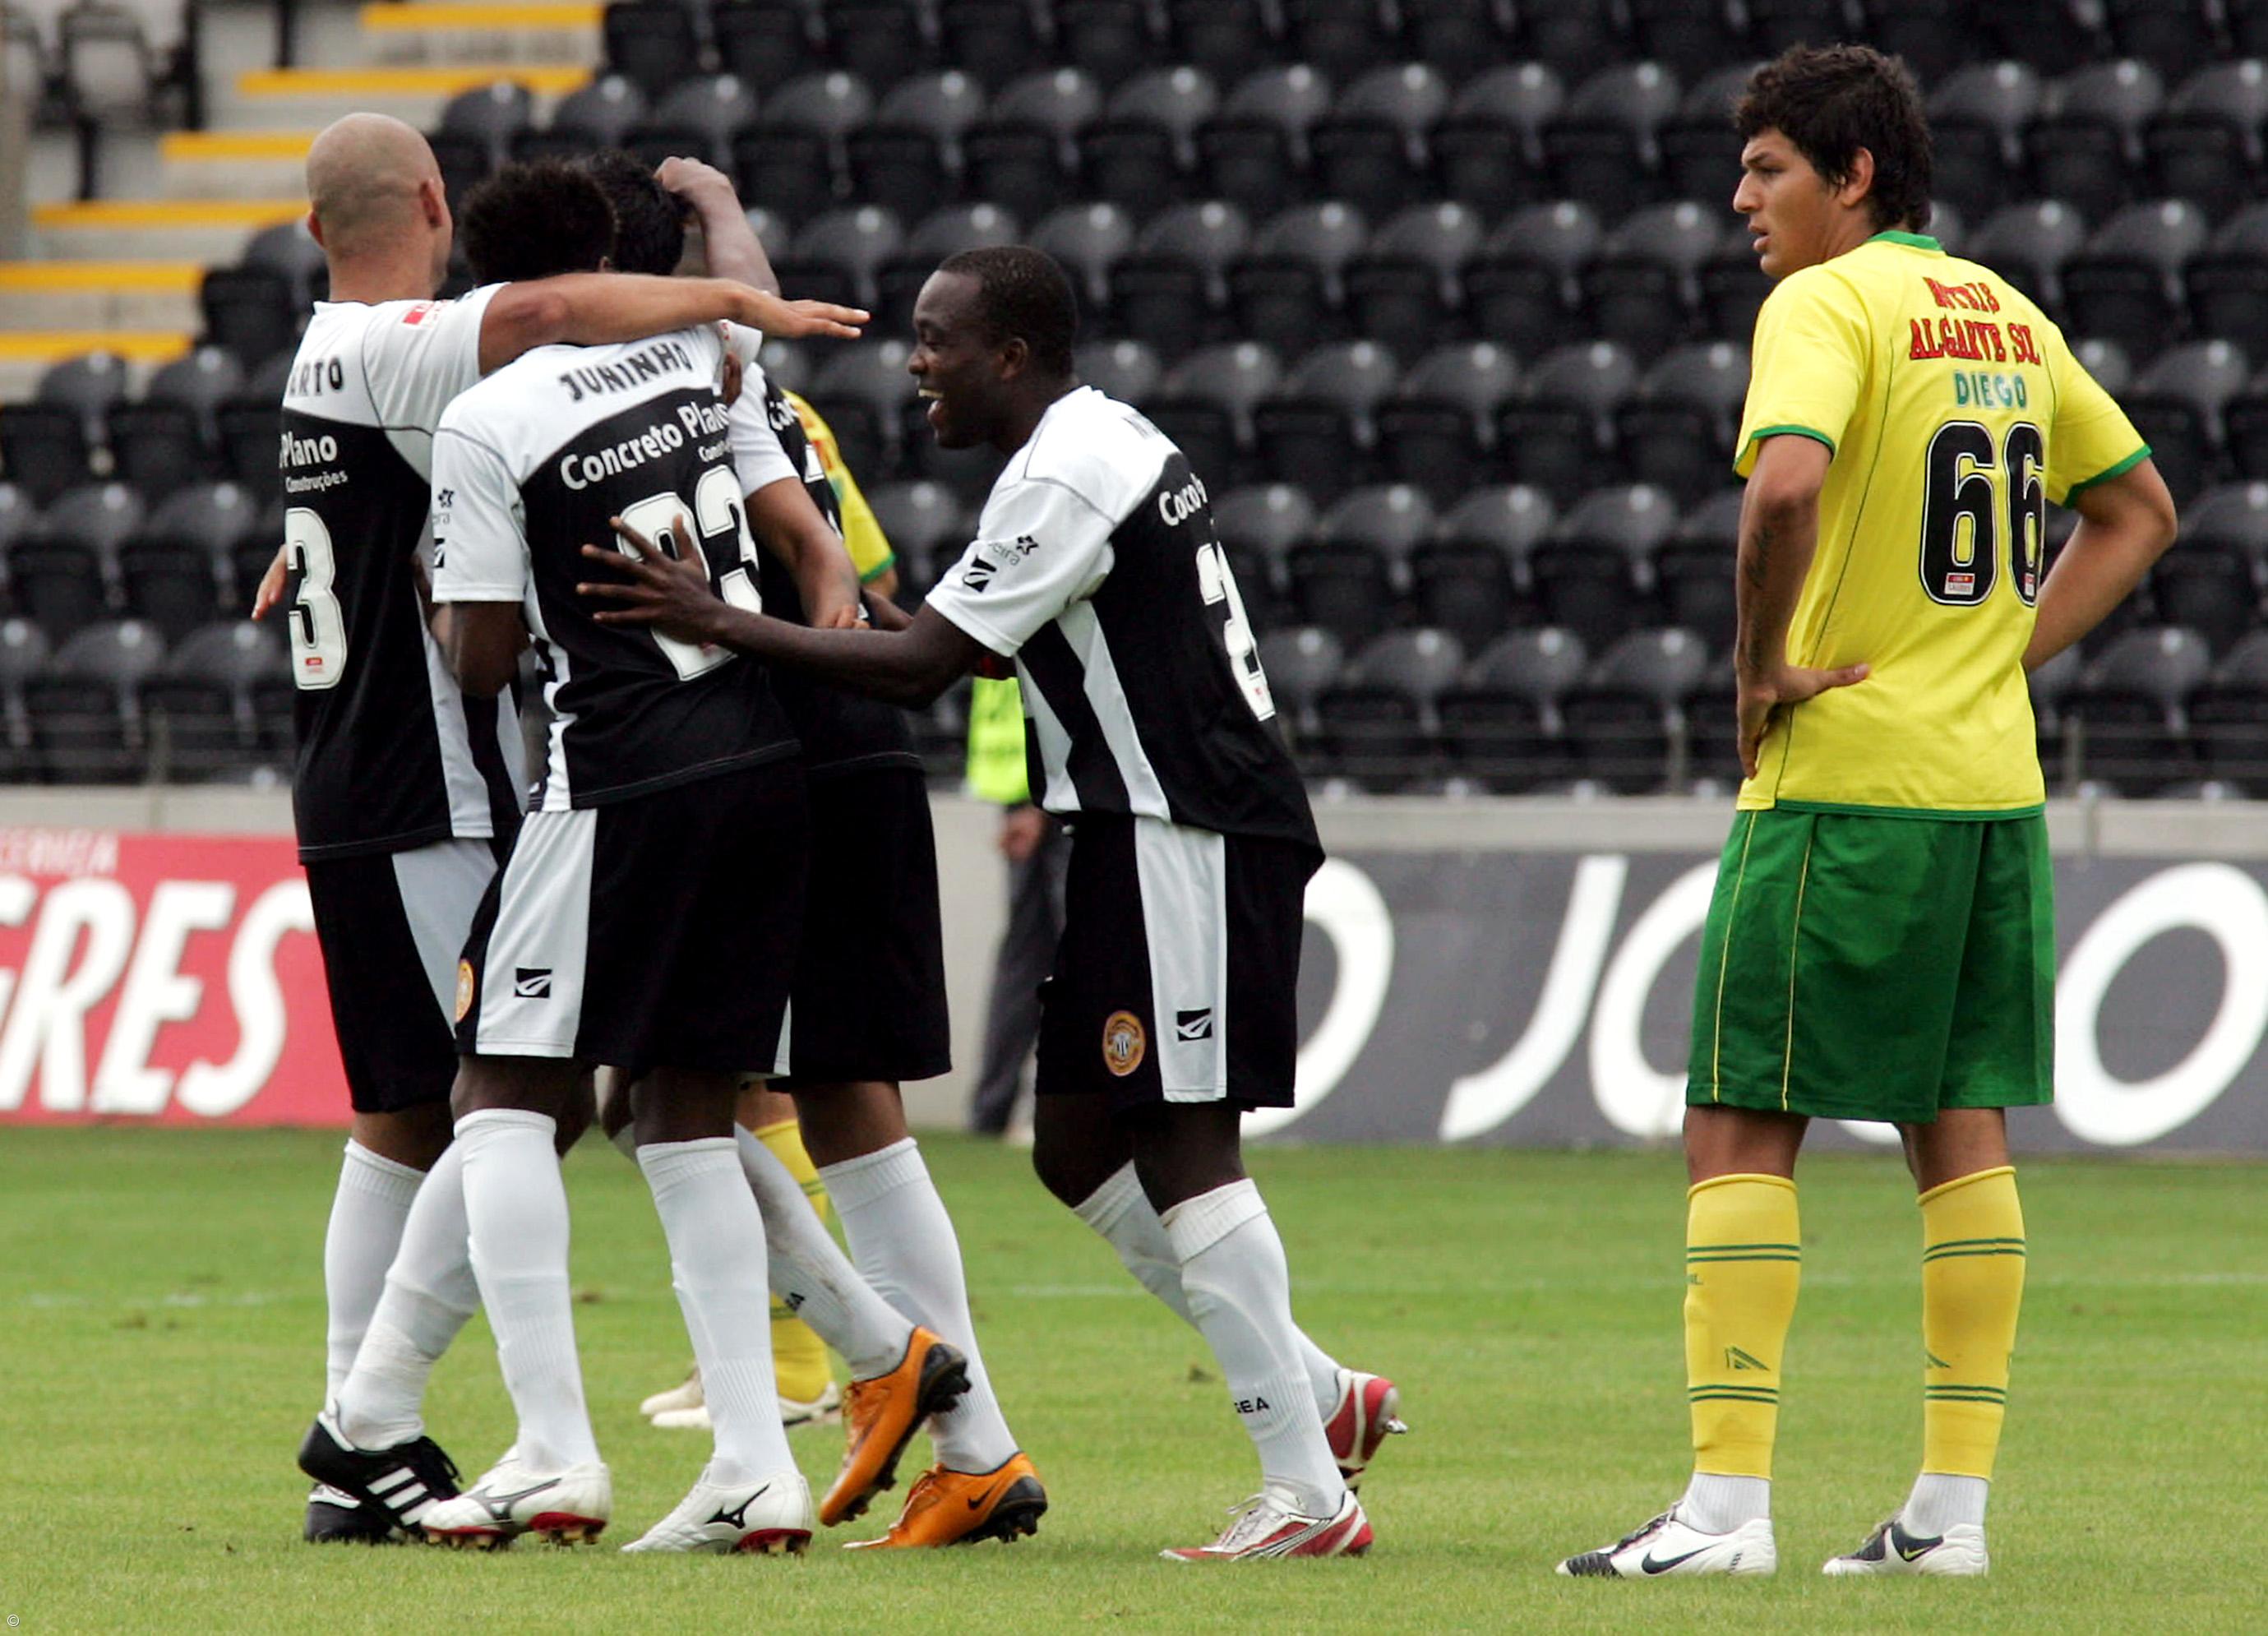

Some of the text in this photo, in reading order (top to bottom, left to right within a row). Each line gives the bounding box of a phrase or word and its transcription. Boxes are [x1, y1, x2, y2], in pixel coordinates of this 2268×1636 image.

[559, 341, 693, 401] JUNINHO
[1953, 371, 2028, 409] DIEGO
[560, 423, 684, 490] Concreto
[677, 400, 731, 438] Plan
[1919, 420, 2047, 607] 66
[285, 506, 348, 691] 3
